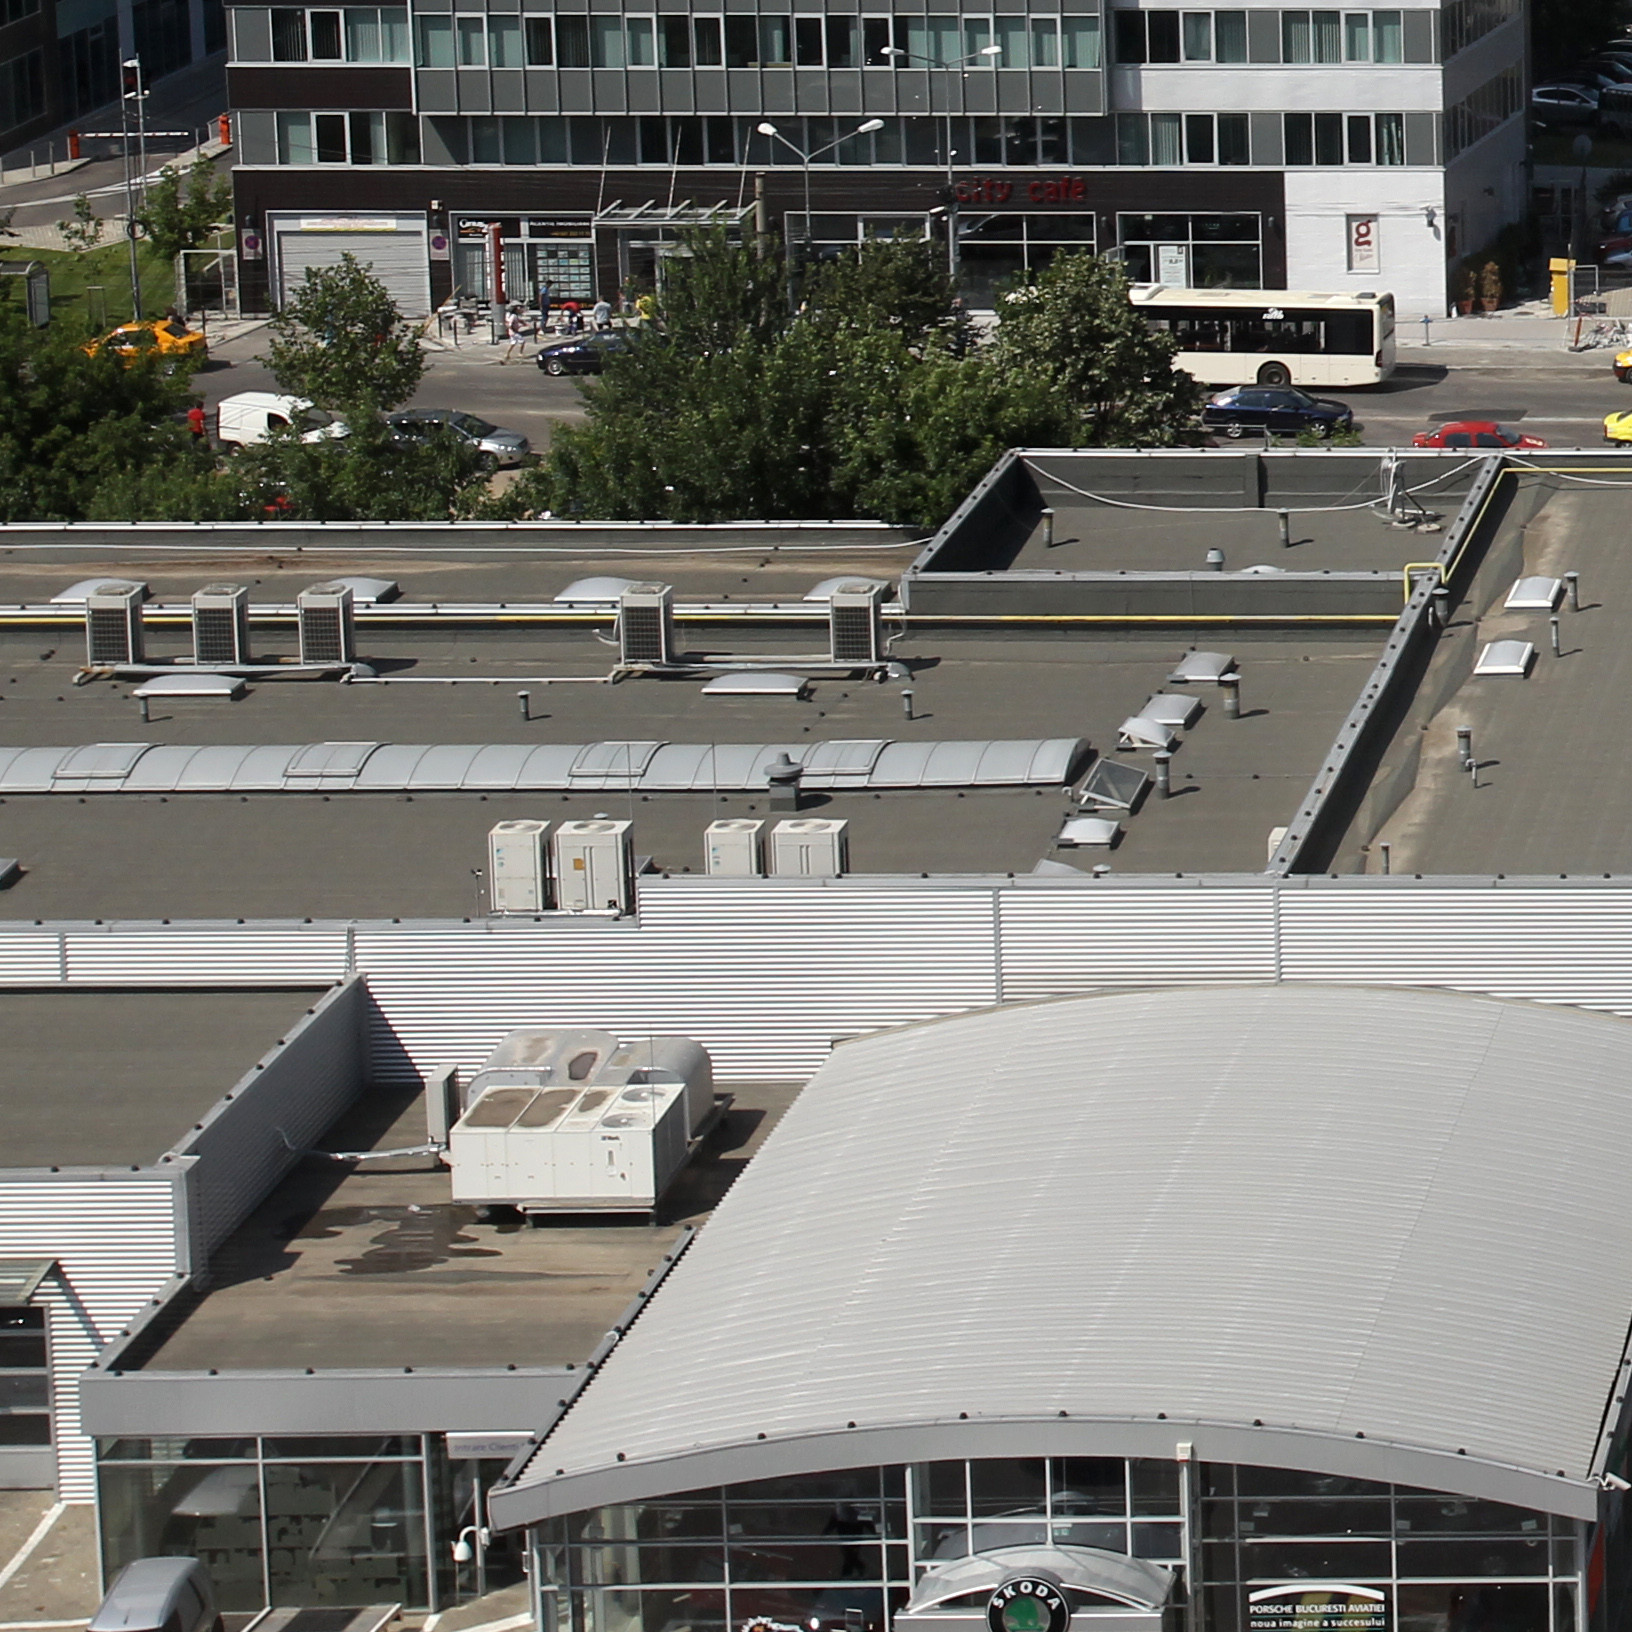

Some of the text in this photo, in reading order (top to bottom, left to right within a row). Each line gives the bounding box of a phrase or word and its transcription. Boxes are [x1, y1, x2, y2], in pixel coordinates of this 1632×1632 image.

[955, 176, 1013, 201] city
[1250, 1603, 1385, 1614] PORSCHE BUCURESTI AVIATIEI
[1251, 1617, 1385, 1629] noua imagine a succesului
